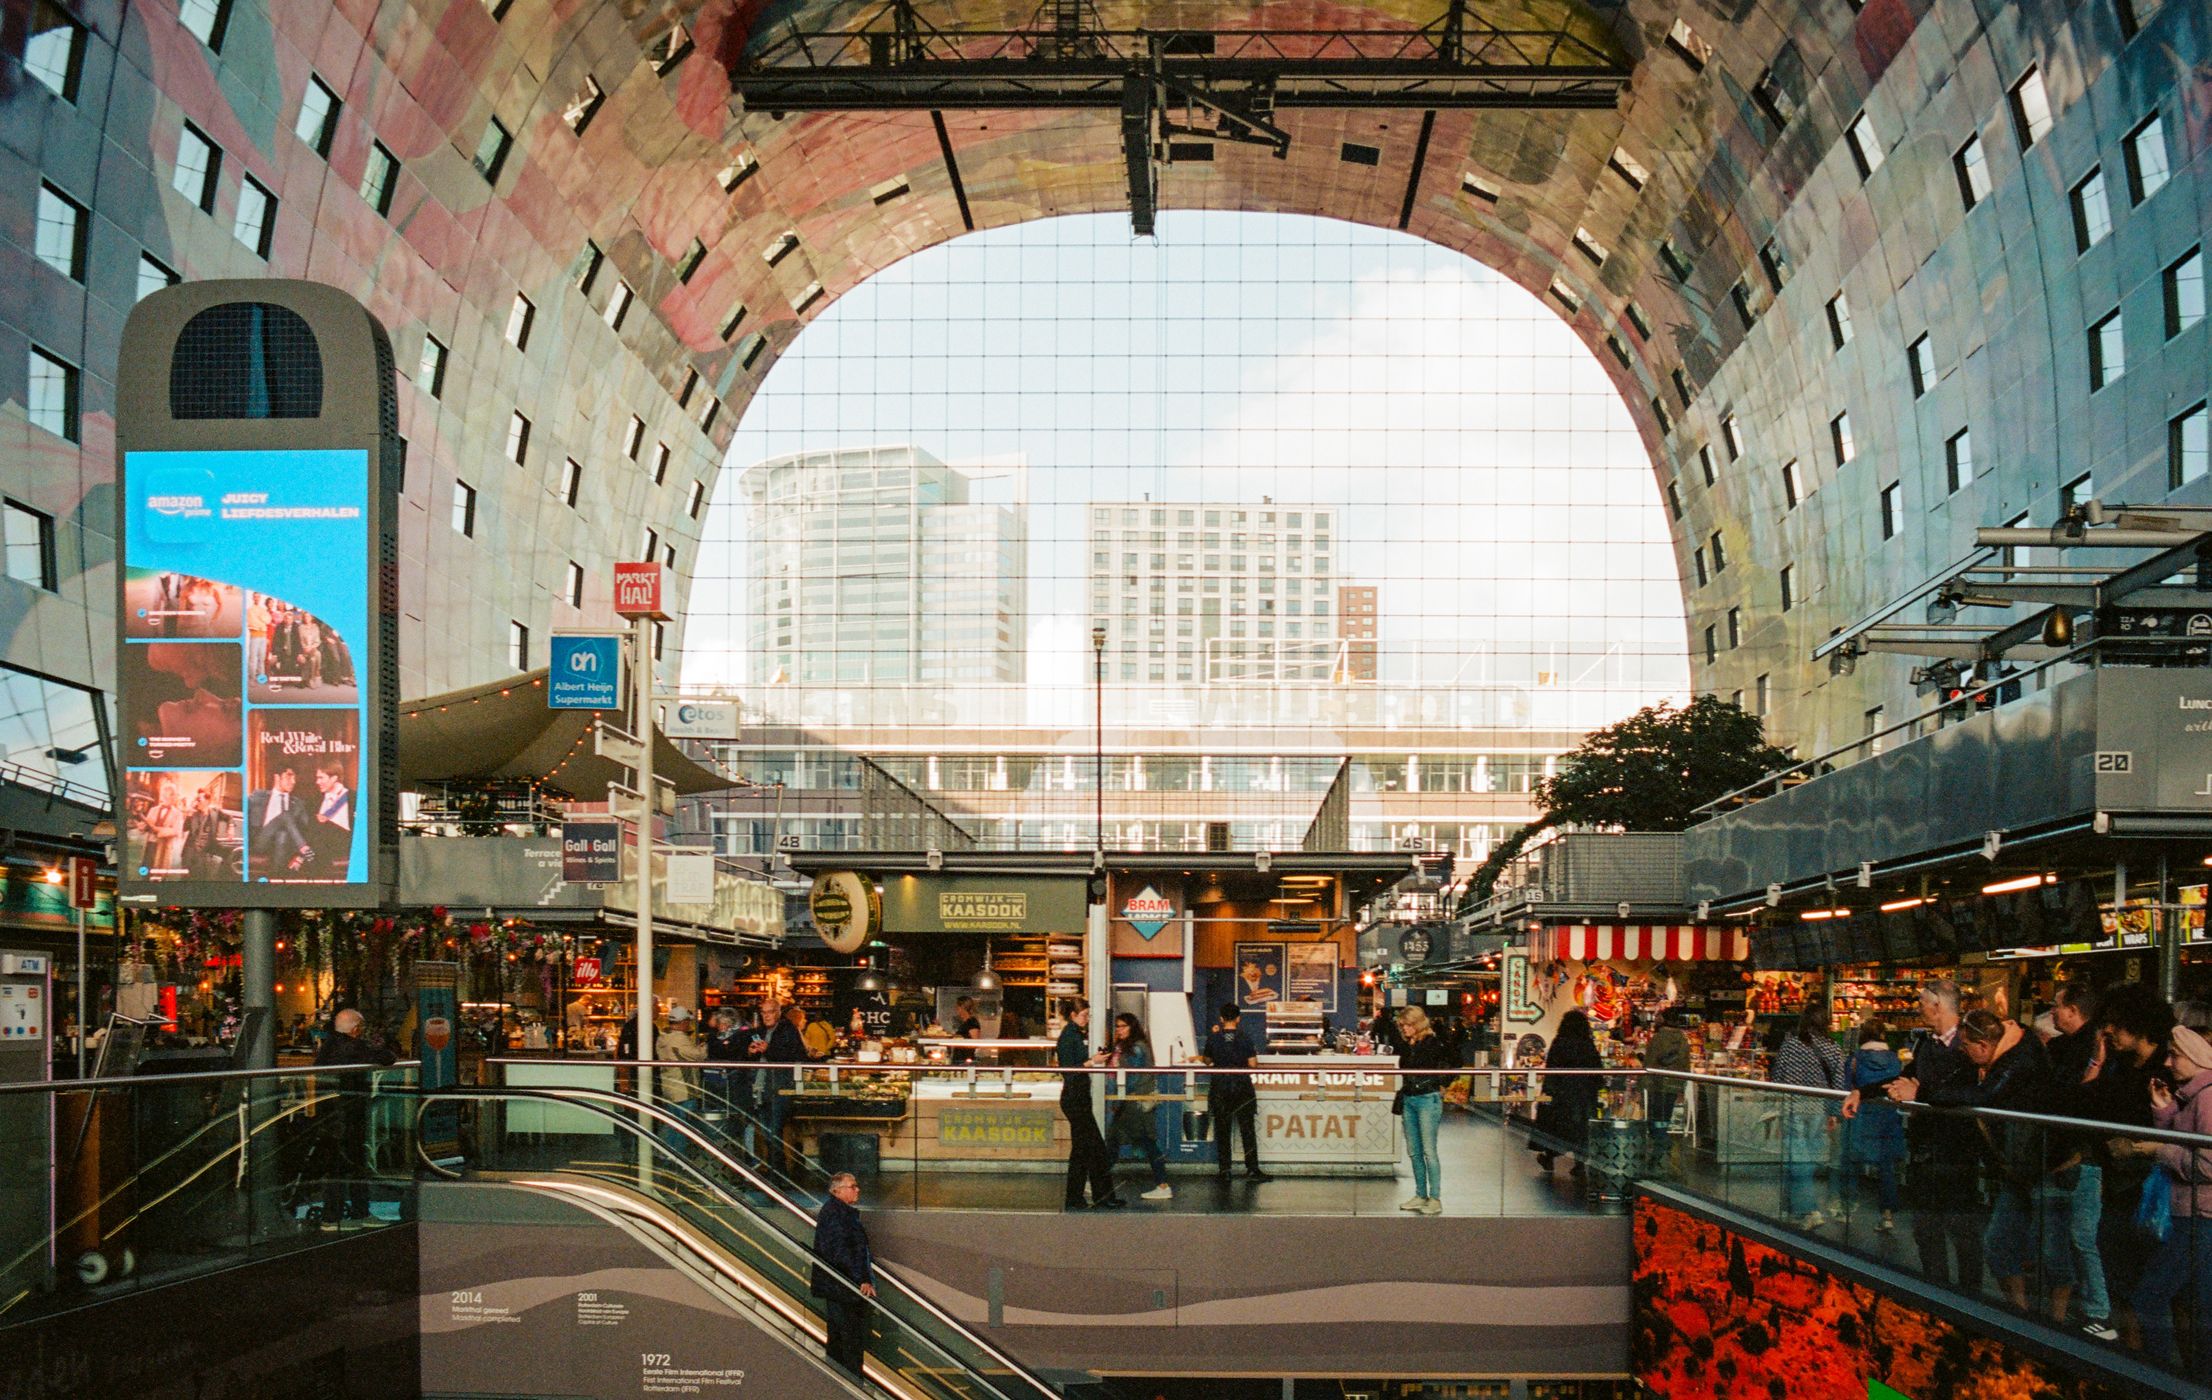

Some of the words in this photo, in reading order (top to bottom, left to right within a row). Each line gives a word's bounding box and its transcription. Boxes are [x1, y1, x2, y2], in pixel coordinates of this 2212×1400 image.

[147, 496, 203, 507] amazon
[222, 493, 268, 504] JUICY
[222, 508, 359, 518] LIEFDESVERHALEN
[617, 573, 658, 584] MARKT
[621, 580, 652, 604] HAL
[554, 682, 585, 691] Albert
[587, 682, 613, 693] Heijn
[555, 695, 612, 705] Supermarkt
[679, 704, 725, 724] etos
[2098, 754, 2129, 771] 20
[565, 839, 588, 852] Gall
[592, 839, 616, 852] Gall
[780, 836, 800, 848] 48
[943, 895, 1004, 903] CROMWIJK
[1128, 898, 1169, 911] BRAM
[943, 904, 1023, 916] KAASDOK
[577, 962, 598, 981] illy
[1513, 961, 1521, 1007] CANDY
[1266, 1115, 1362, 1138] PATAT
[943, 1126, 1046, 1142] KAASDOK
[451, 1291, 483, 1304] 2014
[578, 1293, 598, 1302] 2001
[641, 1354, 671, 1366] 1972
